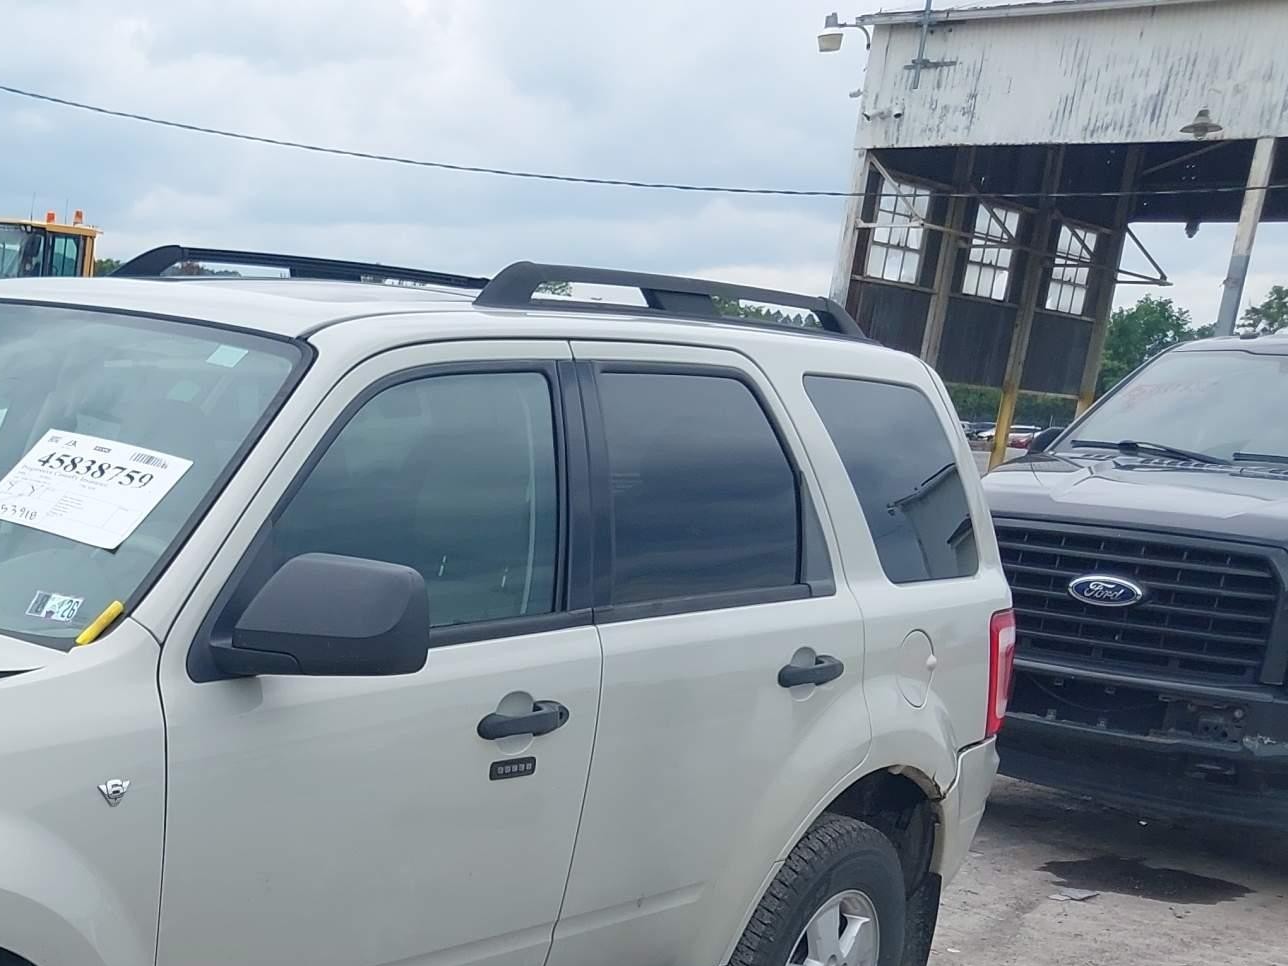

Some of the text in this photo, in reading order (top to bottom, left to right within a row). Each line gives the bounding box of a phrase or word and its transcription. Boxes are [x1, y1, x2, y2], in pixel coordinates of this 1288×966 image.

[38, 451, 154, 489] 45838759
[1083, 581, 1125, 600] Ford
[60, 599, 80, 619] 26
